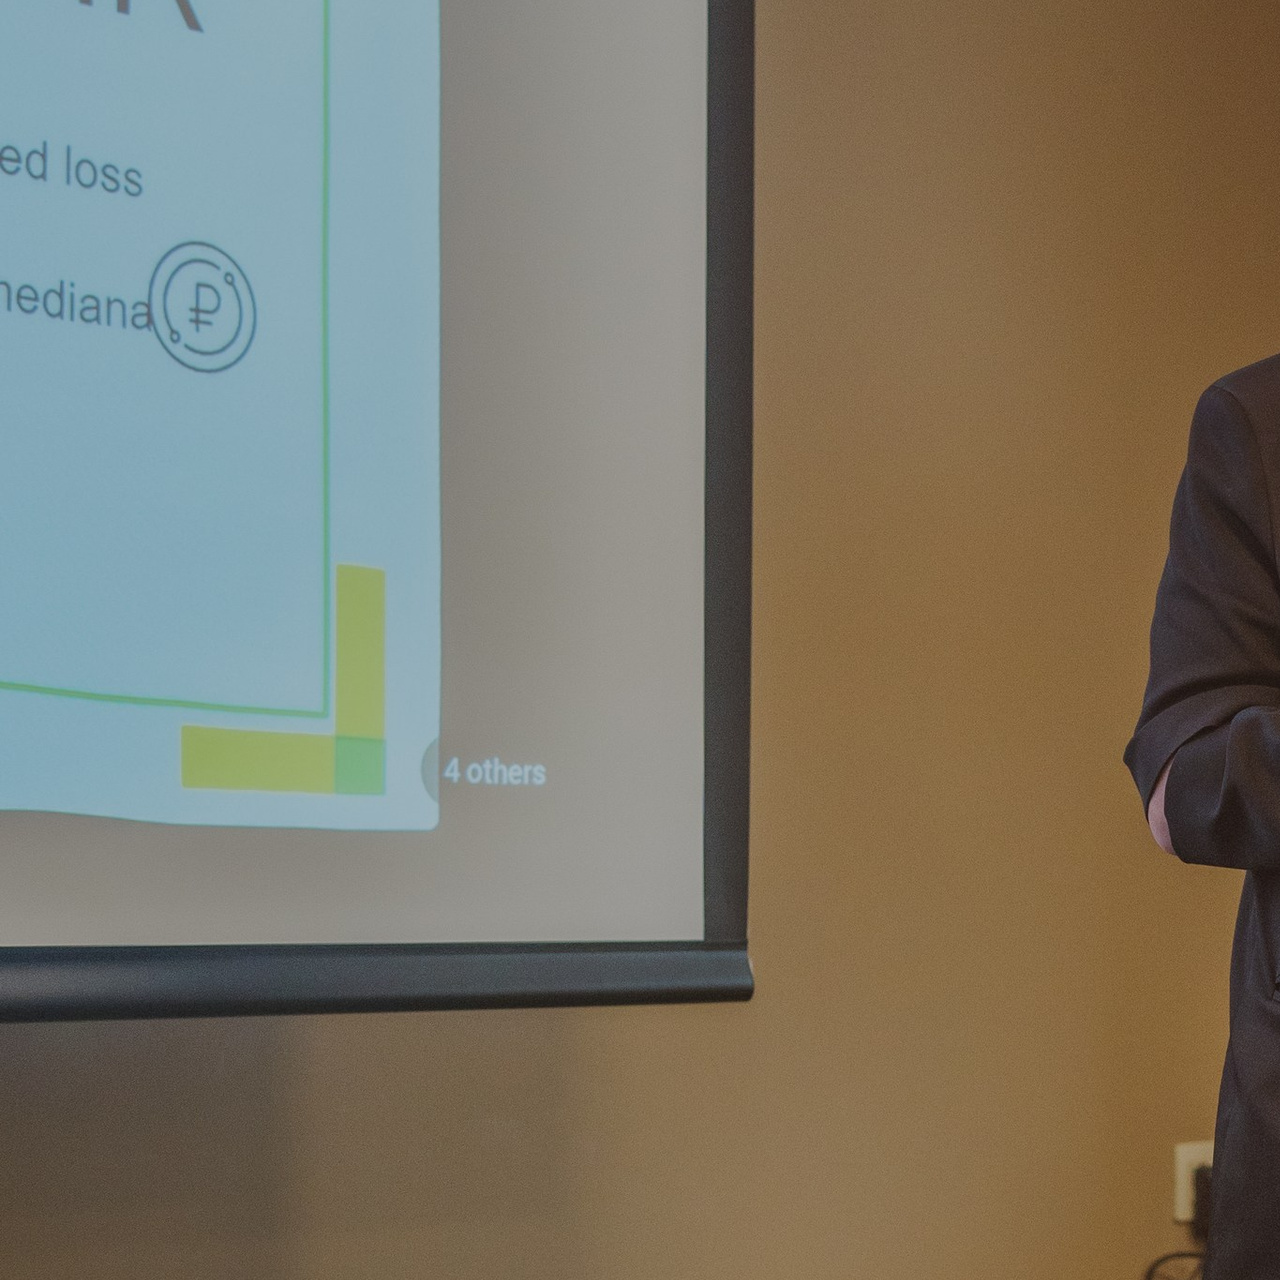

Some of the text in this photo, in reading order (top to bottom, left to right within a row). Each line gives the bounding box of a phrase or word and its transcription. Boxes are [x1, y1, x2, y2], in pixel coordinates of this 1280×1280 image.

[66, 144, 143, 197] loss
[443, 755, 546, 786] 4 others
